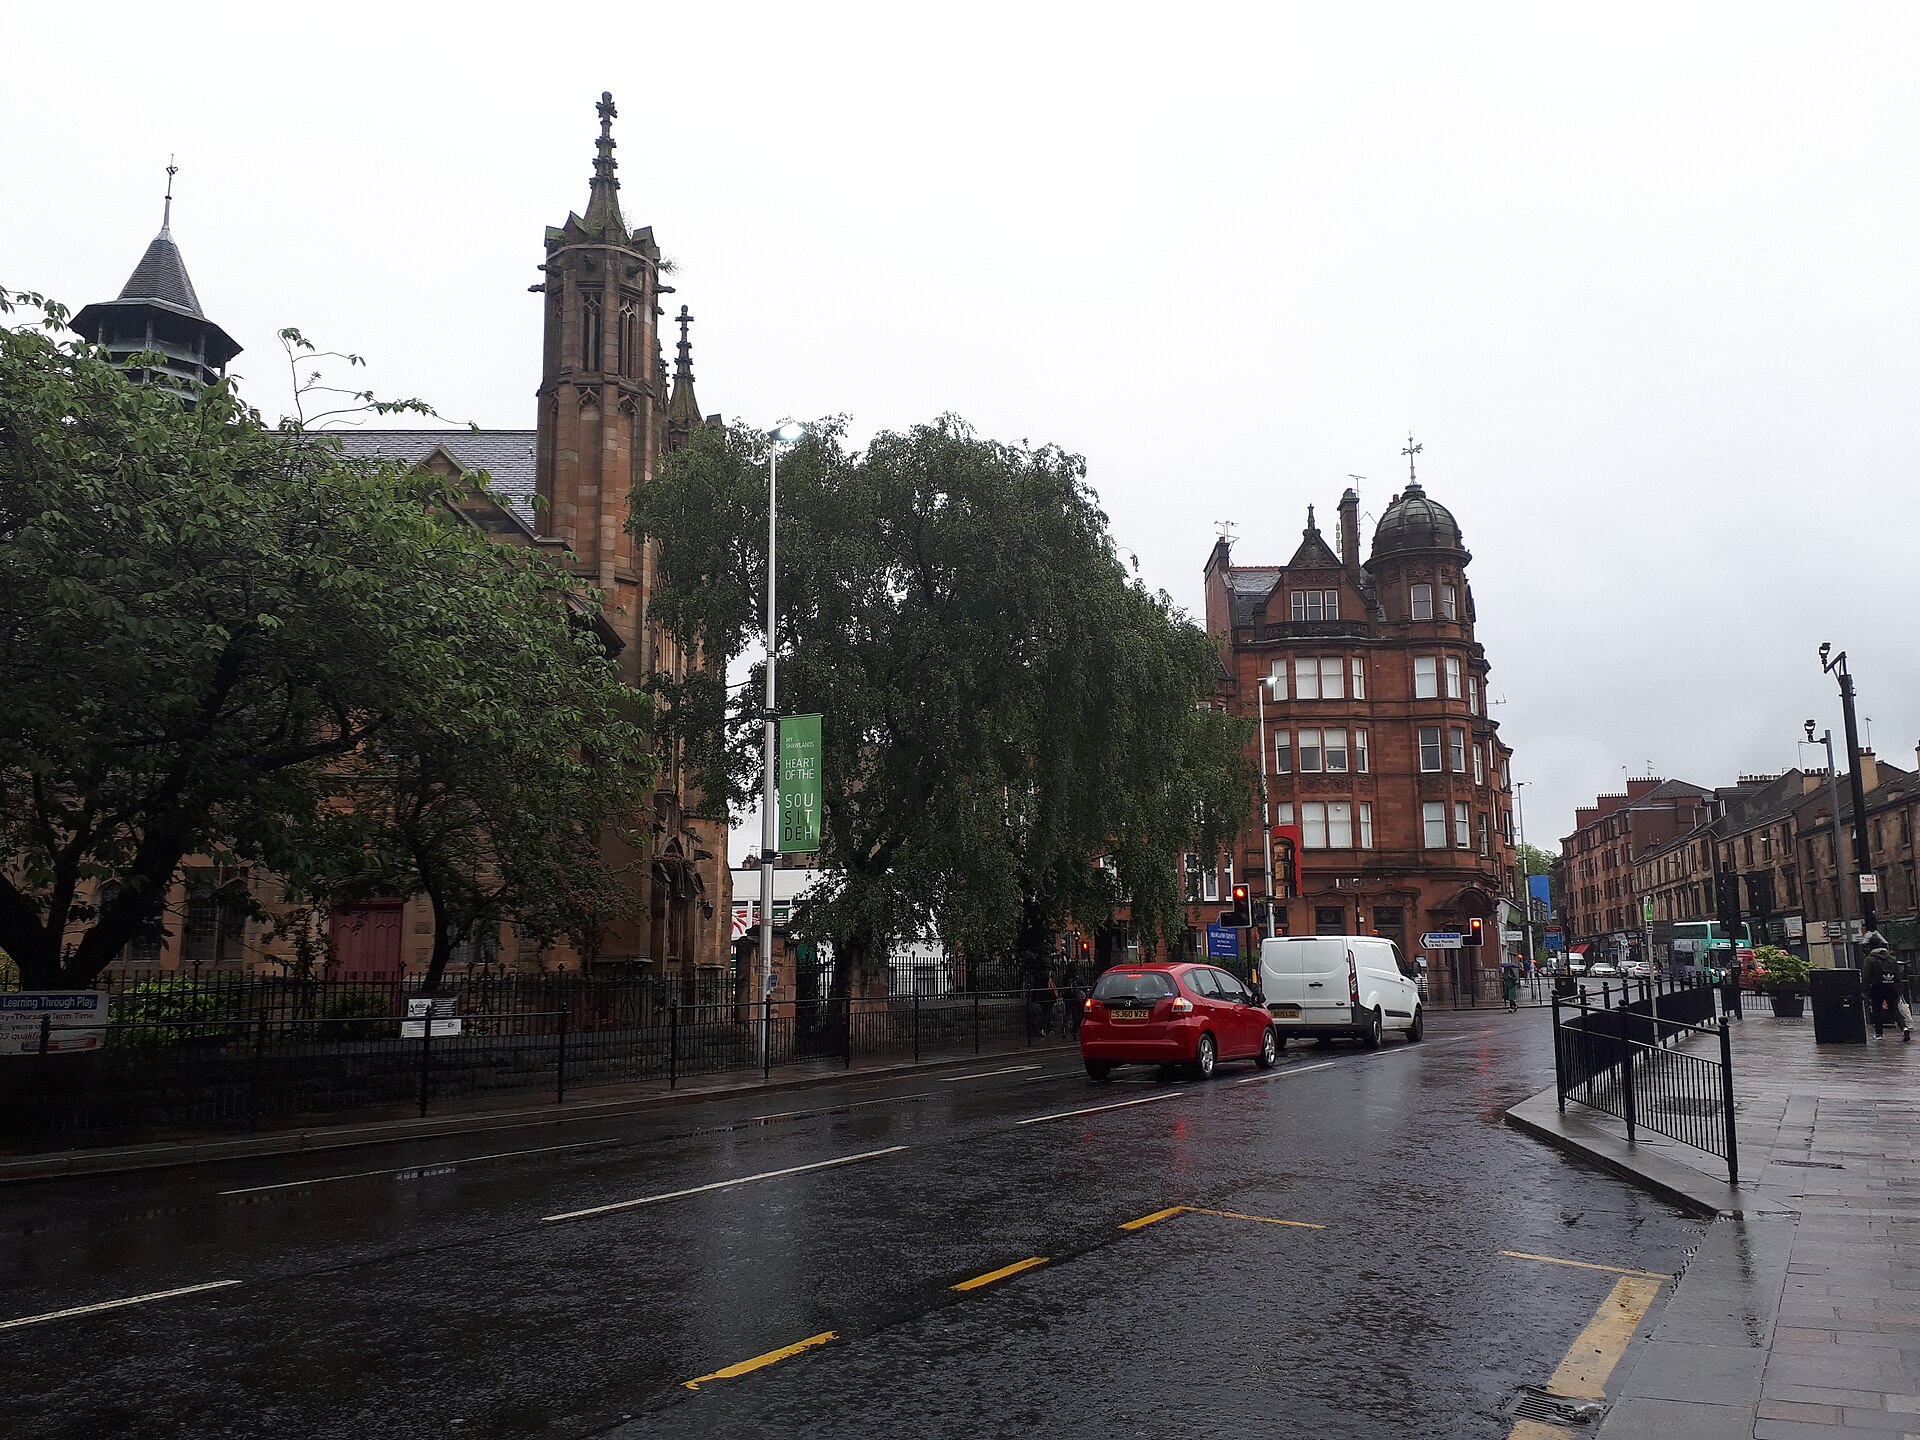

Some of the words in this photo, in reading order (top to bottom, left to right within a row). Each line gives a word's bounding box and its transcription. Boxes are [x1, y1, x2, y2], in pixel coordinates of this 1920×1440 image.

[785, 757, 815, 769] HEART
[785, 769, 796, 781] OF
[797, 768, 815, 780] THE
[3, 997, 38, 1008] Learning
[40, 996, 75, 1008] Through
